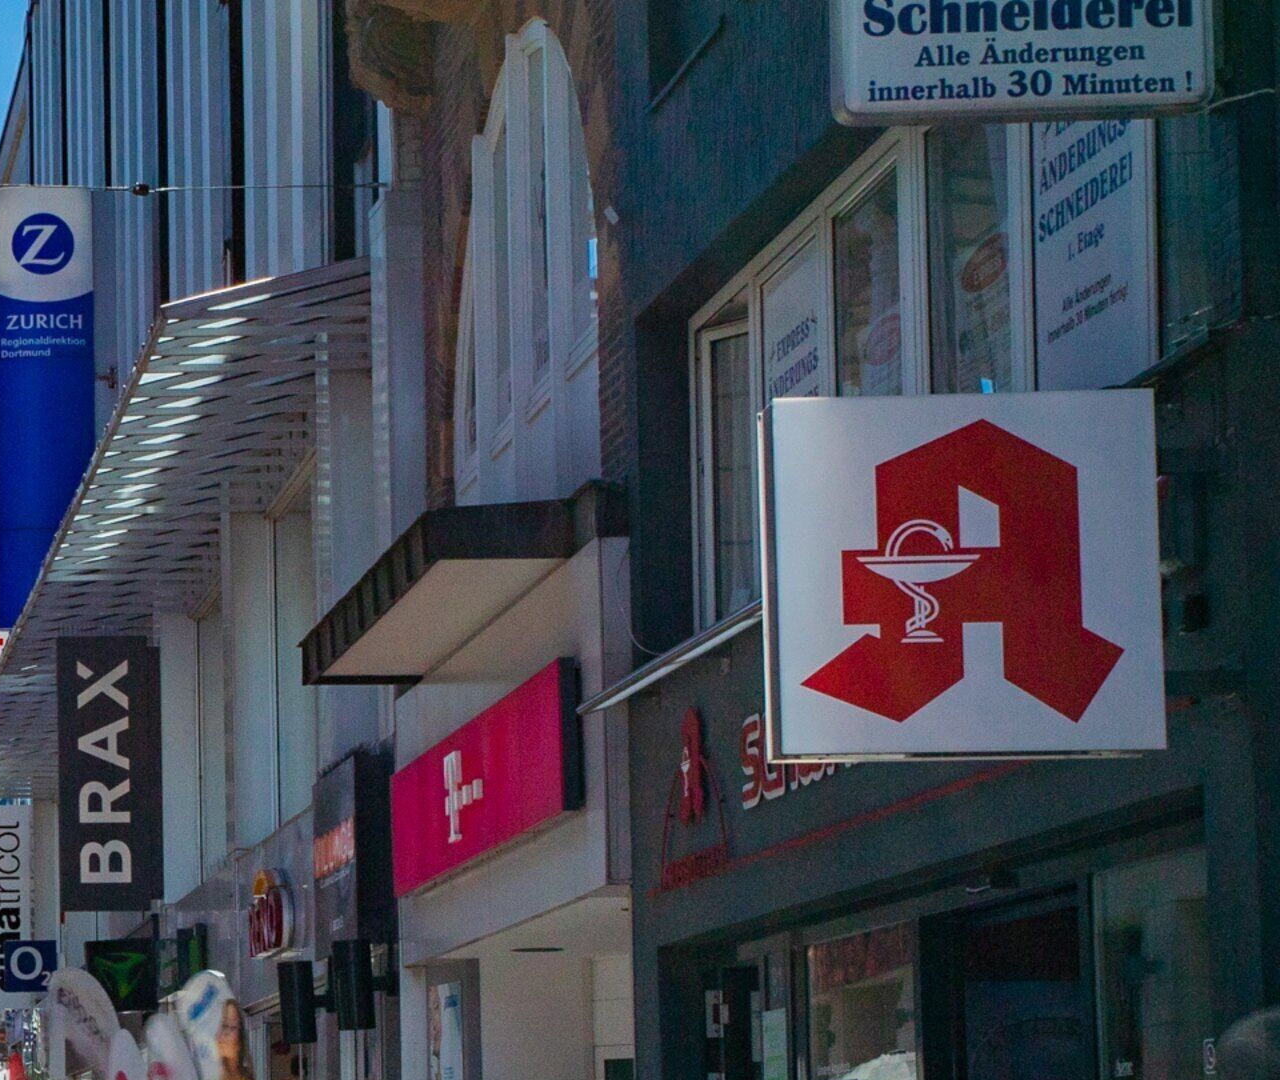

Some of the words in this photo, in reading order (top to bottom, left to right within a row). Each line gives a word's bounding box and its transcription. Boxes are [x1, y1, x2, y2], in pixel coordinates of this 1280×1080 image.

[862, 0, 1194, 37] Schneiderei
[914, 45, 970, 67] Alle
[980, 38, 1146, 66] Änderungen
[868, 78, 997, 102] innerhalb
[1006, 70, 1053, 98] 30
[1062, 74, 1176, 96] Minuten
[1038, 150, 1134, 243] SCHNEIDEREI
[6, 313, 83, 330] ZURICH
[0, 336, 86, 348] Regionaldirektion
[1, 347, 51, 359] Dortmund
[76, 659, 133, 884] BRAX
